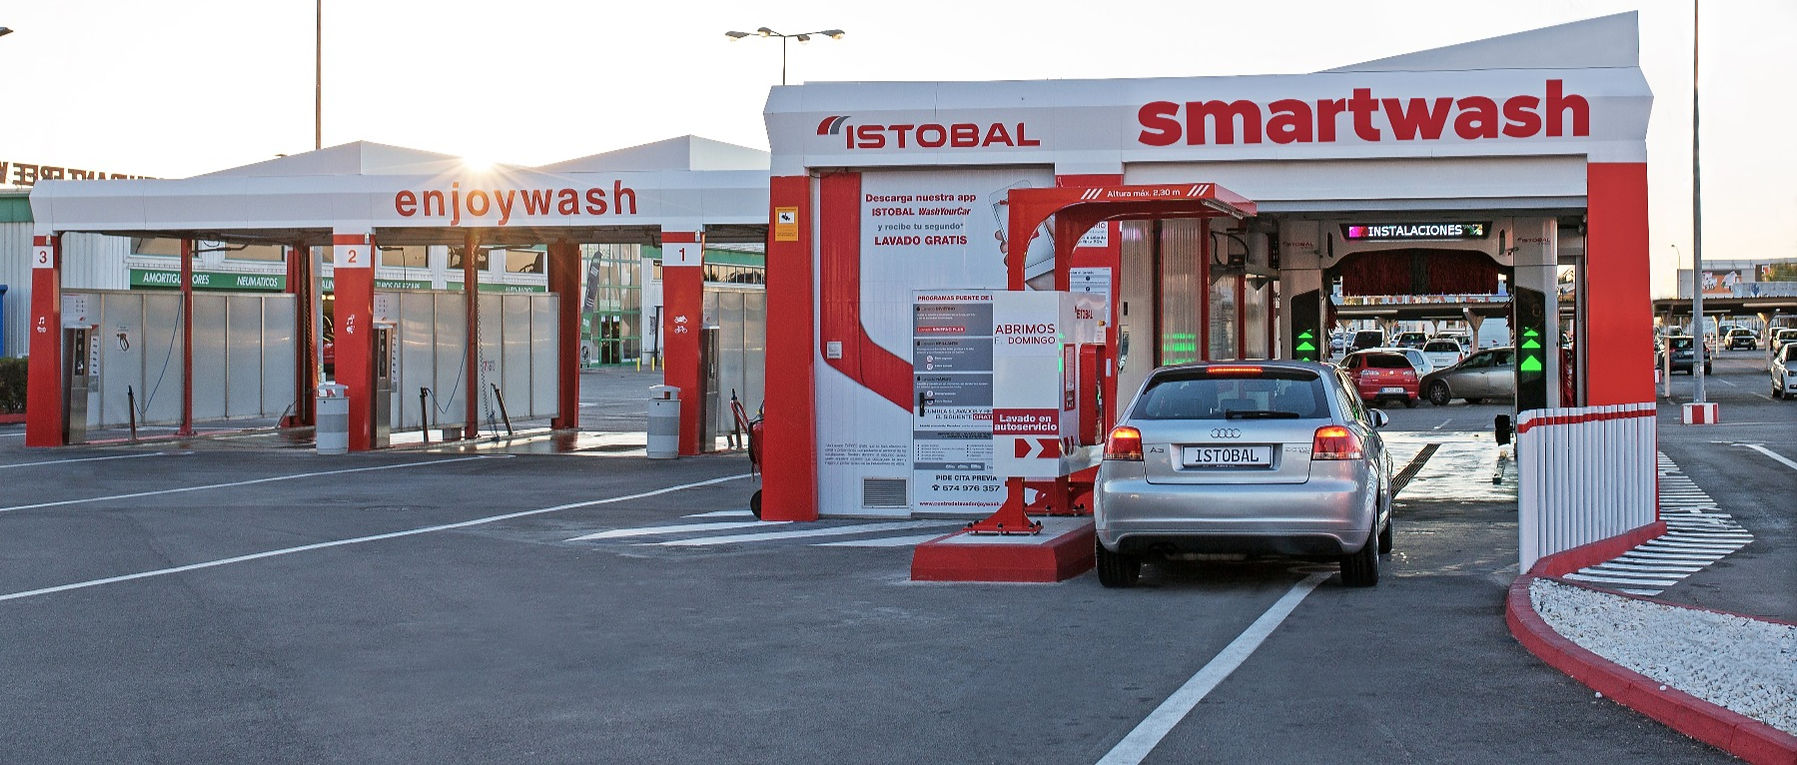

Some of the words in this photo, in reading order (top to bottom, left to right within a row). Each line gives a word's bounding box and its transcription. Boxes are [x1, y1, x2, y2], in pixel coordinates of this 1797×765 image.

[1138, 79, 1590, 146] smartwash
[846, 122, 1041, 150] ISTOBAL
[865, 194, 913, 203] Descarga
[957, 194, 977, 203] app
[1107, 190, 1132, 198] Altura
[395, 180, 637, 226] enjoywash
[872, 208, 915, 216] ISTOBAL
[918, 207, 972, 216] WashYourCar
[1368, 224, 1463, 237] INSTALACIONES
[874, 236, 921, 246] LAVADO
[924, 235, 968, 245] GRATIS
[39, 250, 47, 264] 3
[348, 249, 357, 263] 2
[679, 247, 685, 261] 1
[143, 273, 210, 285] AMORTIGUORES
[236, 276, 278, 288] NEUMATICOS
[995, 324, 1056, 335] ABRIMOS
[1008, 336, 1056, 345] DOMINGO
[999, 414, 1035, 423] Lavado
[1037, 415, 1052, 423] en
[994, 422, 1057, 432] autoservicio
[1195, 449, 1259, 463] ISTOBAL
[982, 484, 1000, 492] 357
